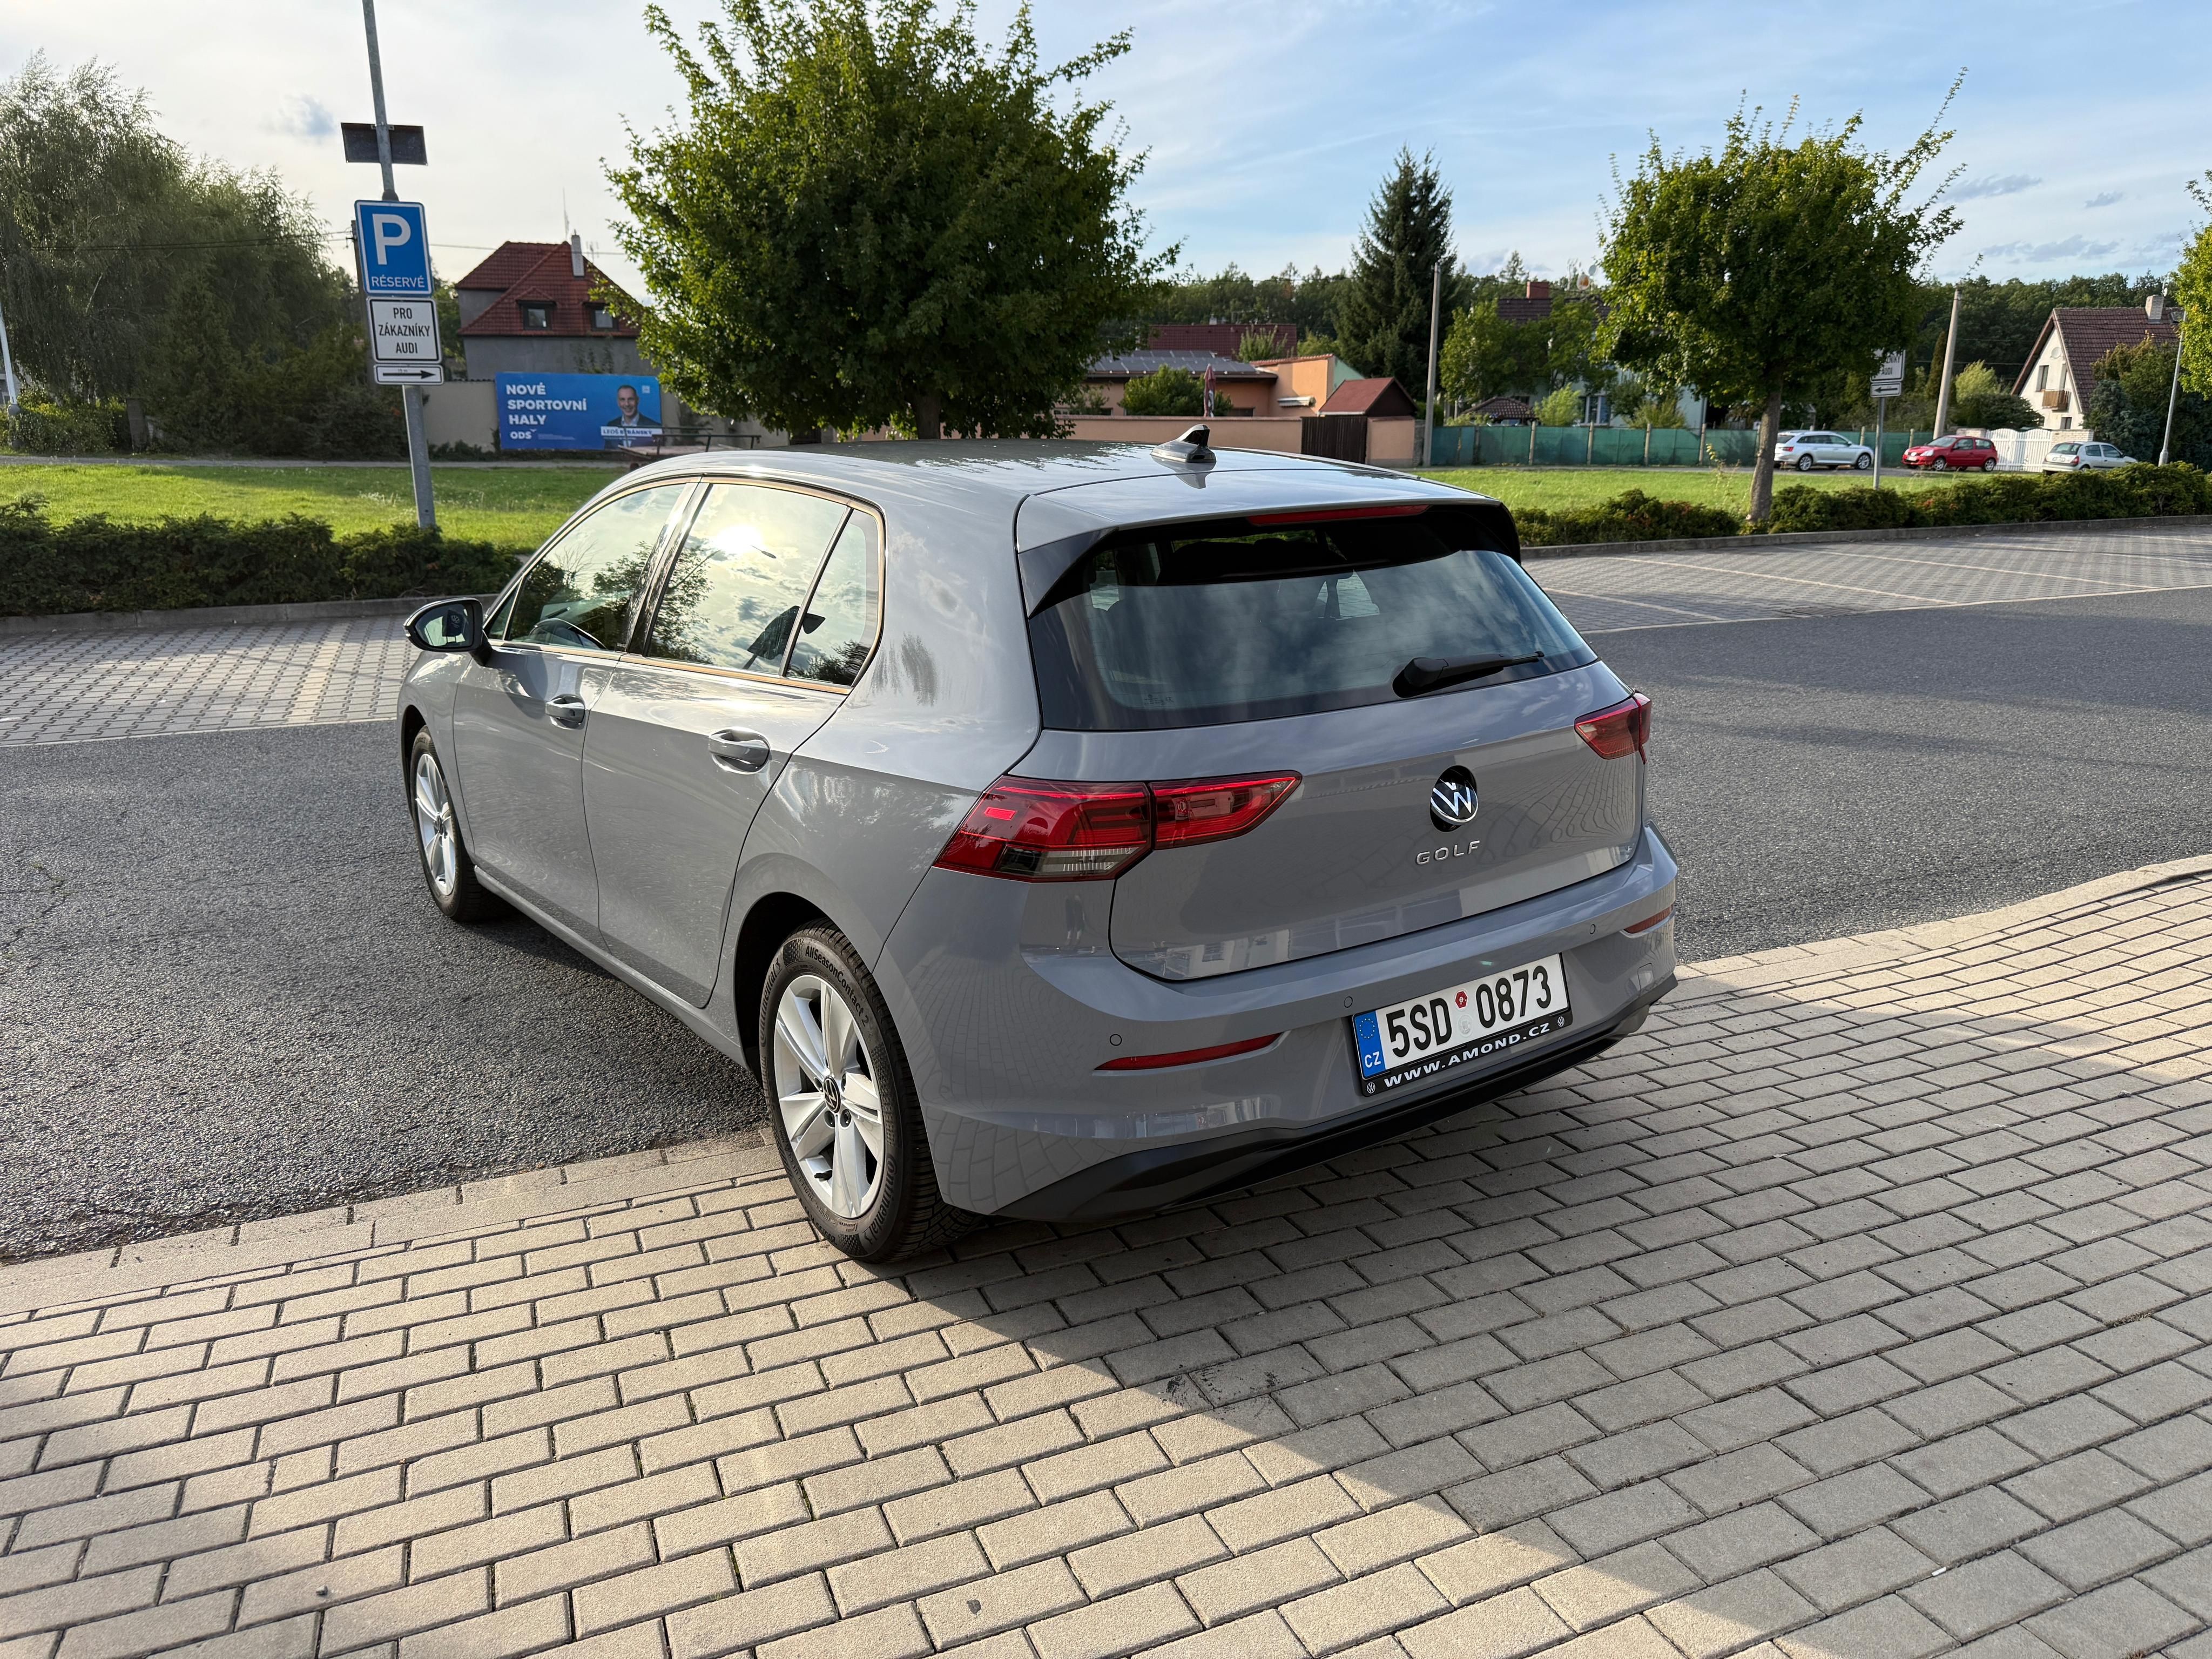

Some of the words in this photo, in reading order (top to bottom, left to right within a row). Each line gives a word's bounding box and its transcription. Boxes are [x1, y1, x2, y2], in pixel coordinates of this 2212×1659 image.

[373, 214, 411, 265] P
[372, 275, 425, 288] RÉSERVÉ
[393, 307, 413, 319] PRO
[379, 323, 430, 337] ZÁKAZNÍKY
[396, 342, 418, 354] AUDI
[506, 382, 546, 395] NOVÉ
[507, 398, 587, 410] SPORTOVNÍ
[509, 414, 547, 425] HALY
[510, 431, 532, 440] ODS
[1415, 840, 1480, 865] GOLF
[805, 946, 864, 1017] AllSeasonContact
[861, 1015, 868, 1027] 2
[1386, 997, 1452, 1057] 5SD
[1475, 965, 1552, 1028] 0873
[1364, 1051, 1381, 1068] CZ
[1384, 1024, 1550, 1087] WWW.AMOND.CZ
